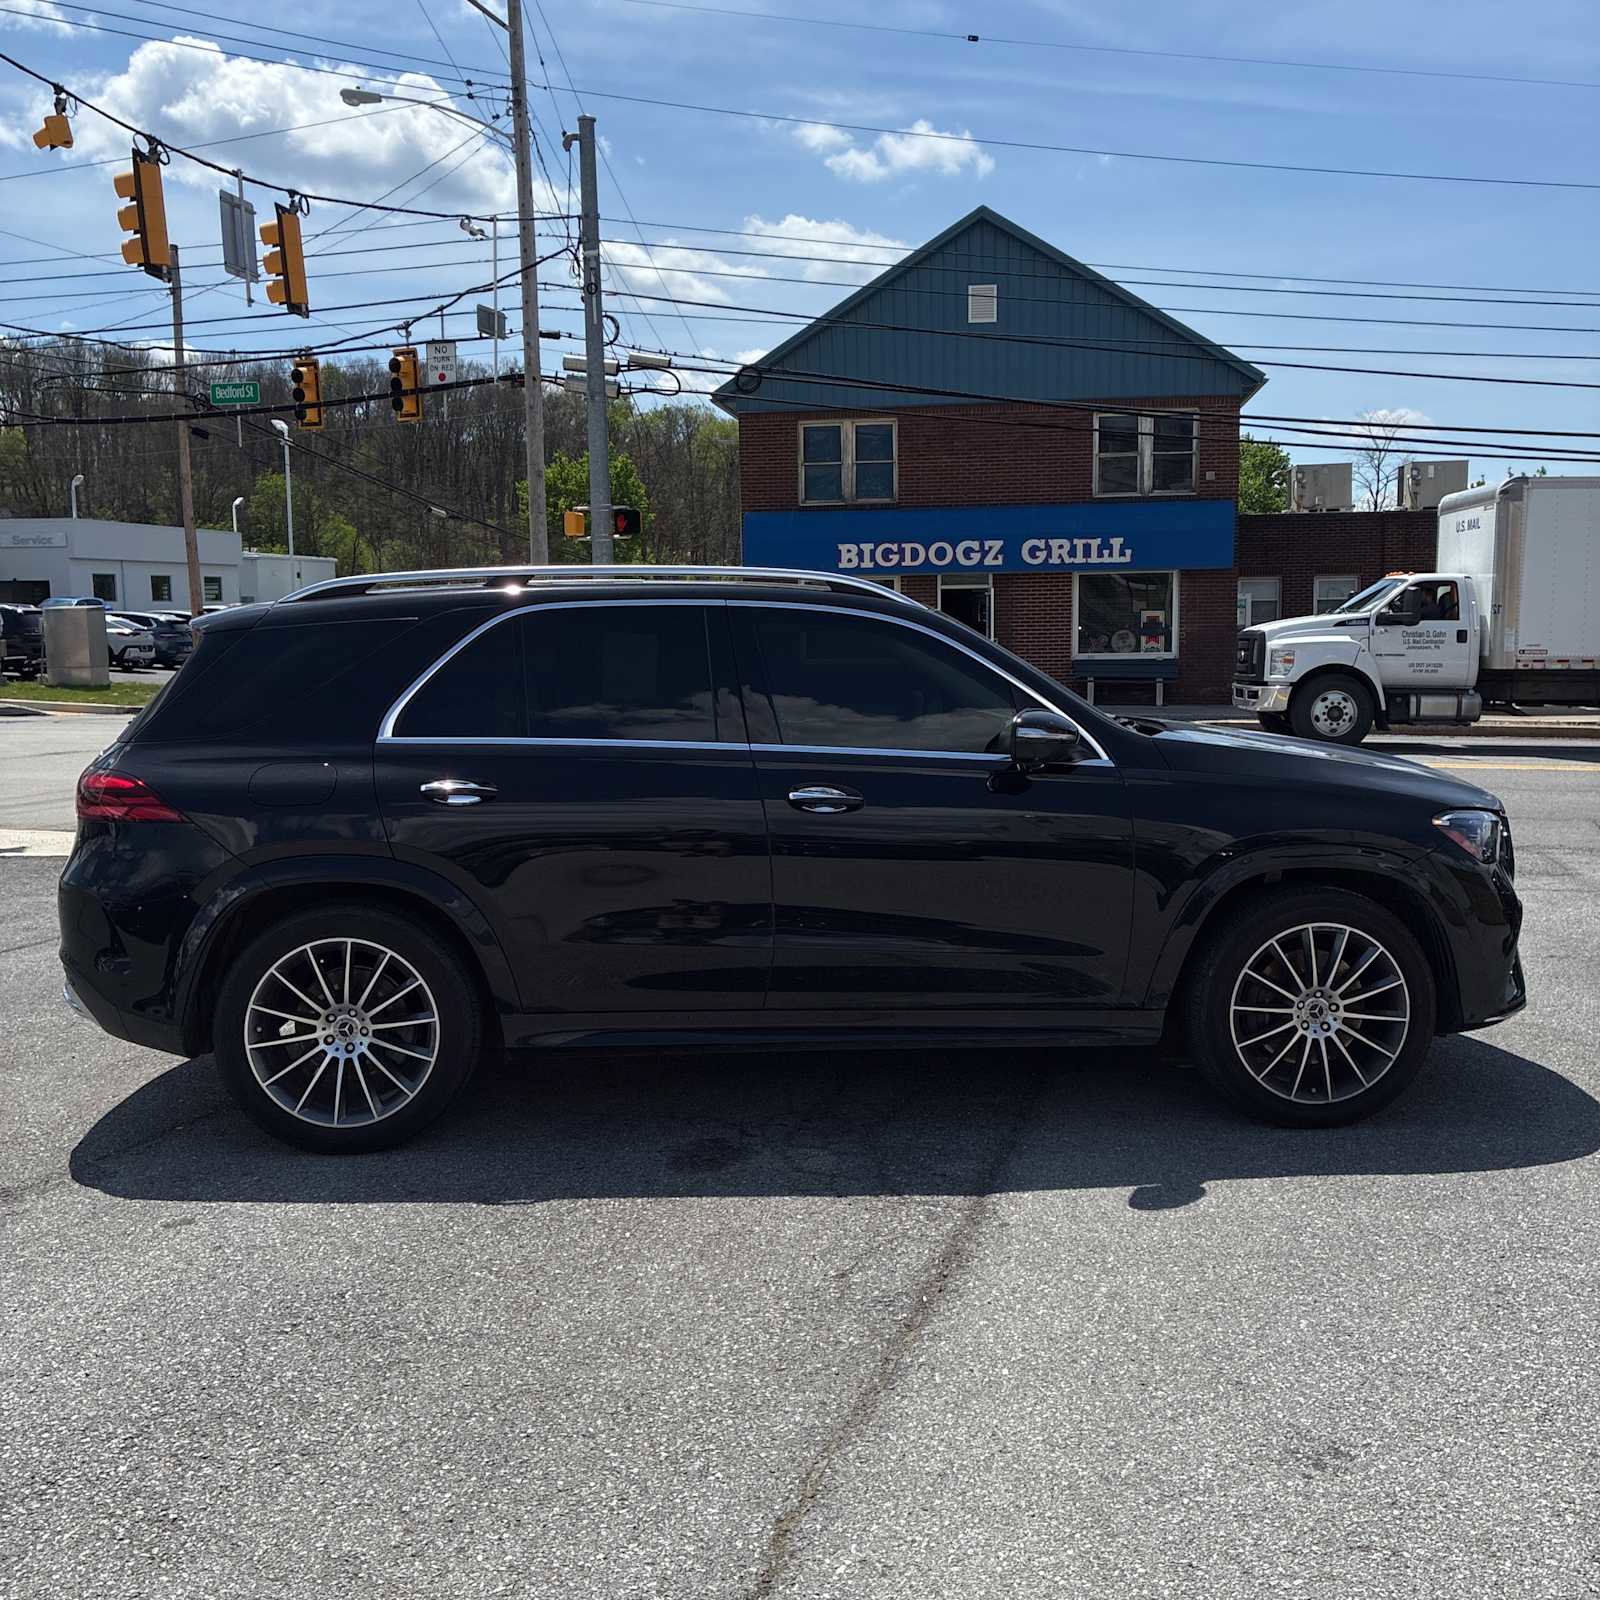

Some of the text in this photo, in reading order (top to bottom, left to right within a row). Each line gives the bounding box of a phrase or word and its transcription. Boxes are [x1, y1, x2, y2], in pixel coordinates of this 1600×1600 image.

[434, 346, 448, 354] NO
[433, 355, 451, 363] TURN
[215, 384, 254, 399] Bedford St
[1456, 517, 1481, 533] U.S. MAIL
[11, 535, 54, 545] Service
[837, 537, 1132, 569] BIGDOGZ GRILL
